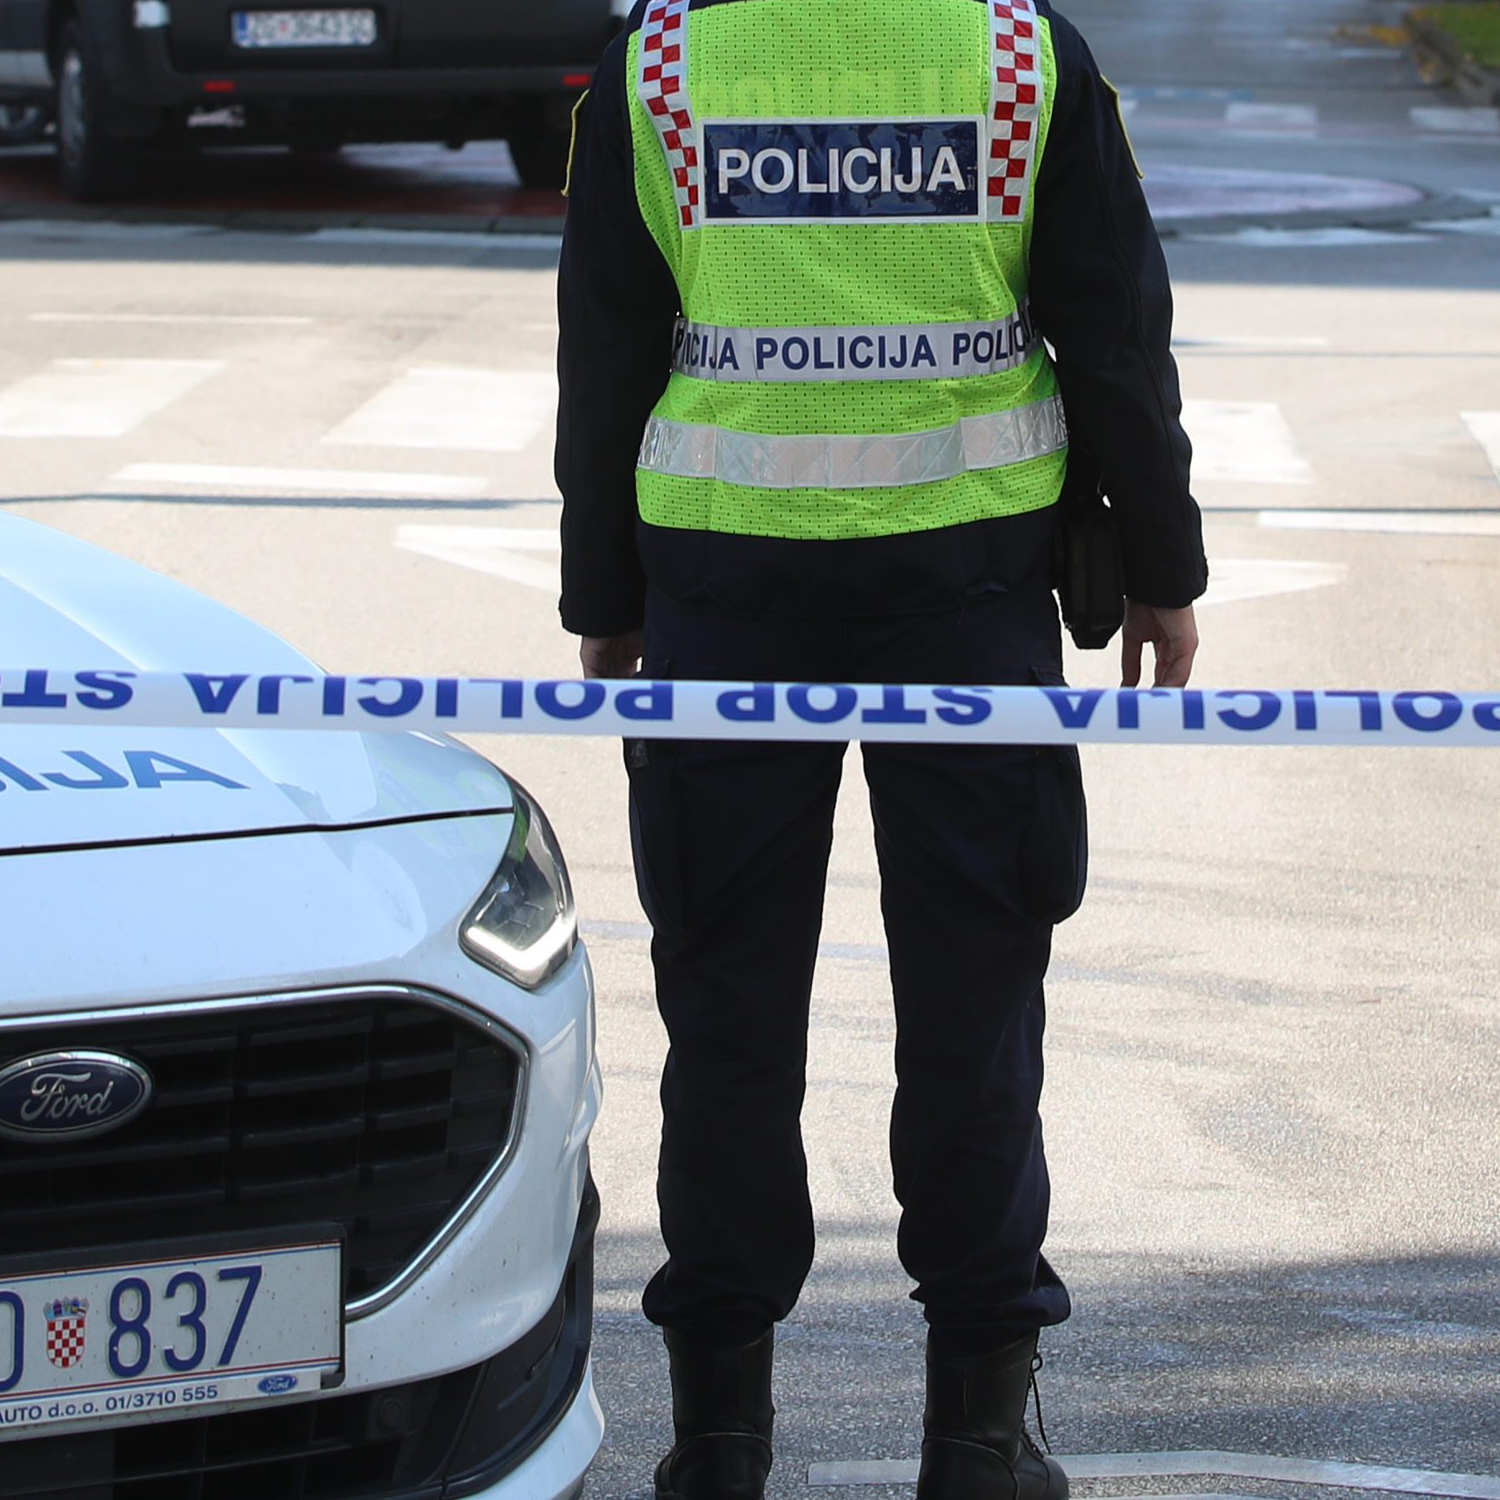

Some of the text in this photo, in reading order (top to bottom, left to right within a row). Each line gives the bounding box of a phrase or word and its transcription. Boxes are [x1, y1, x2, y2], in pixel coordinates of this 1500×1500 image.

[717, 145, 966, 194] POLICIJA
[755, 334, 937, 371] POLICIJA
[184, 673, 673, 720] POLICIJA
[716, 681, 992, 725] STOP
[19, 1071, 116, 1122] Ford
[107, 1265, 263, 1379] 837
[48, 1401, 99, 1418] d.o.o.
[105, 1389, 176, 1411] 01/3710
[182, 1384, 218, 1401] 555
[265, 1375, 296, 1391] Ford
